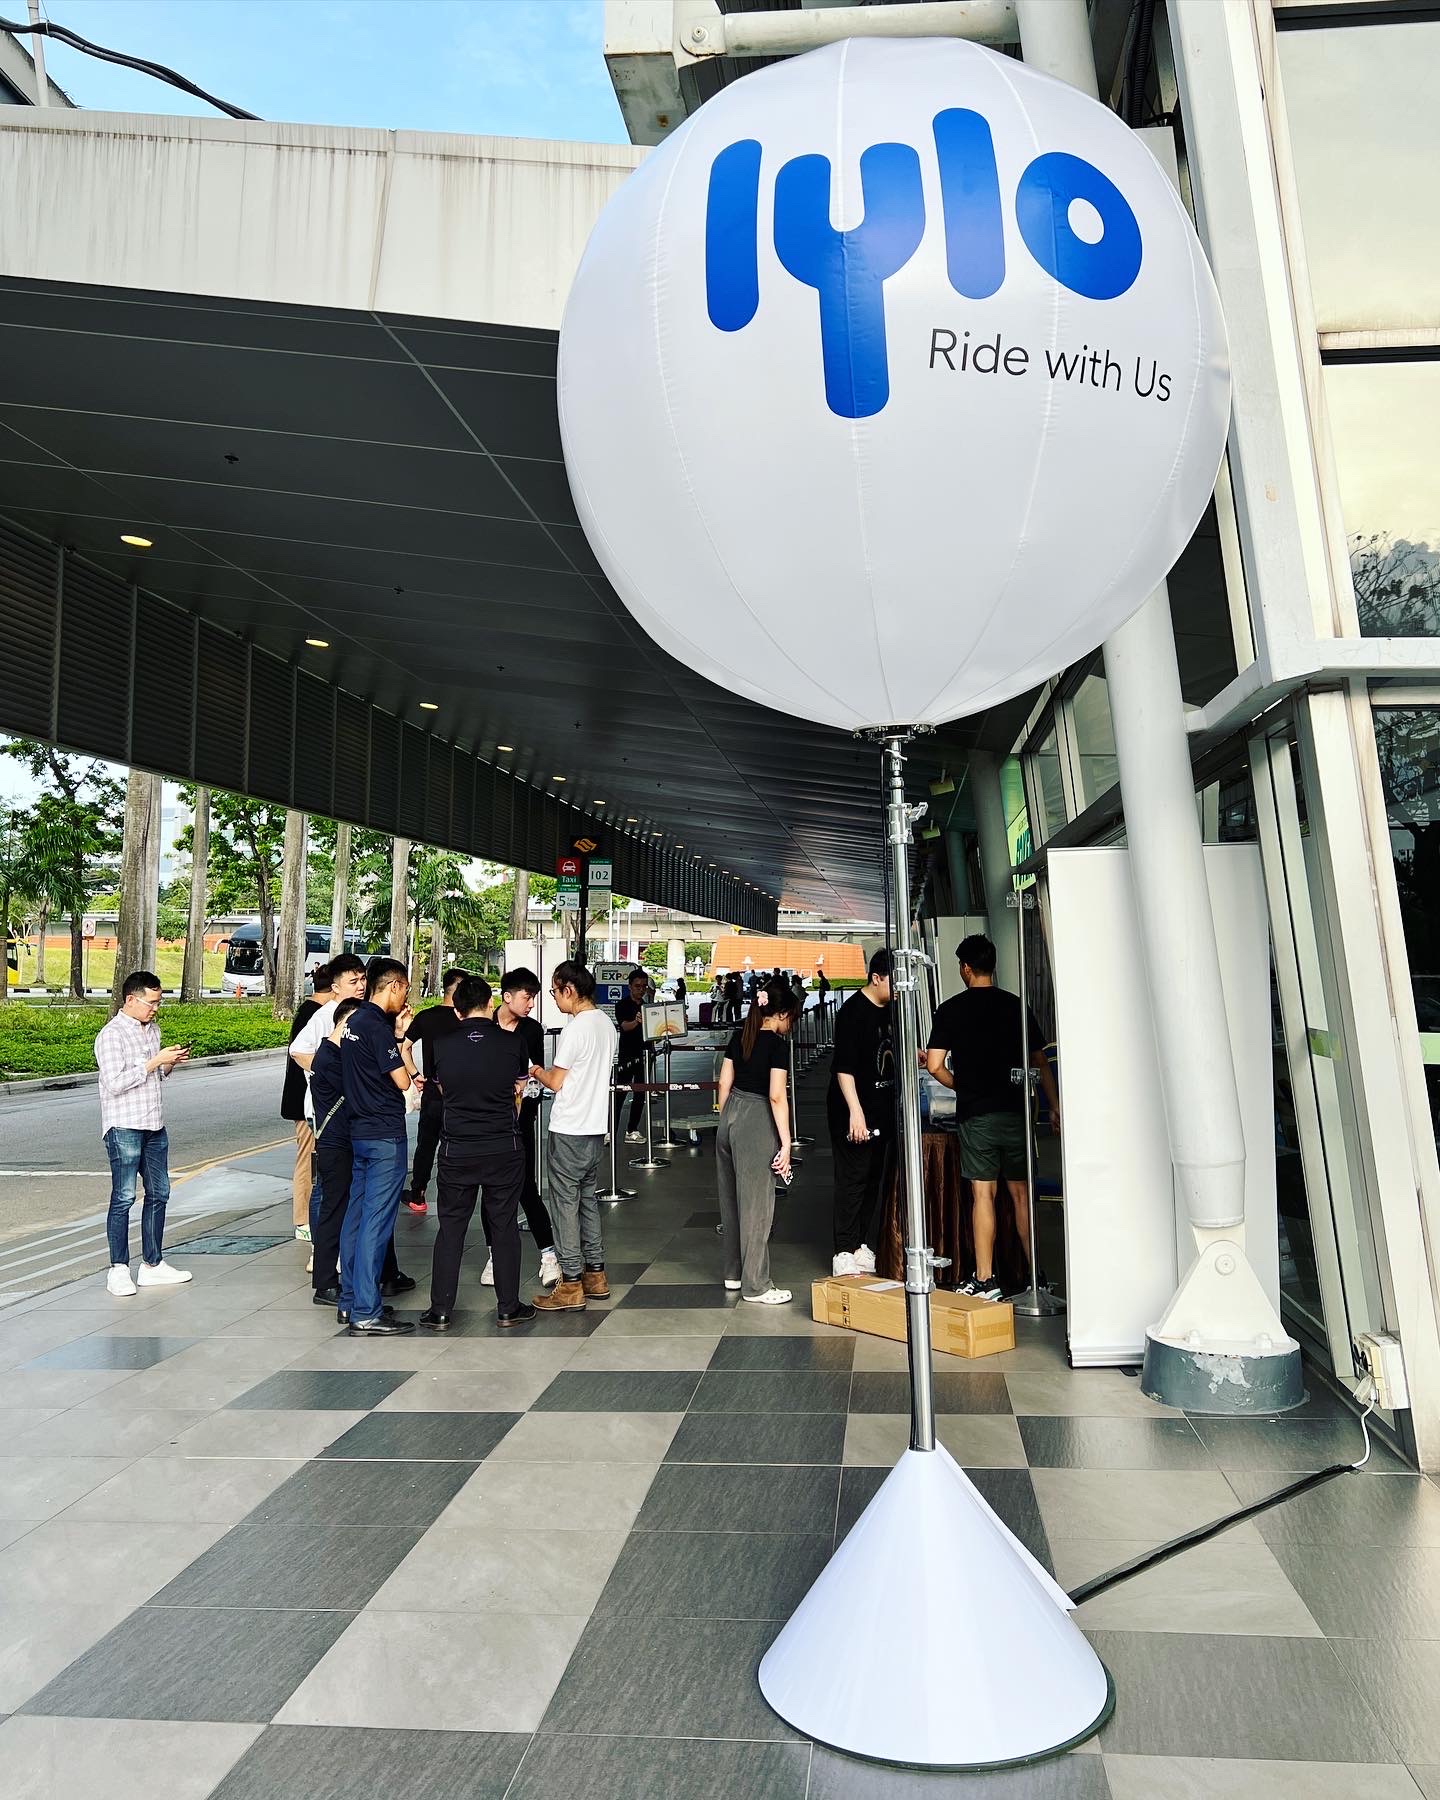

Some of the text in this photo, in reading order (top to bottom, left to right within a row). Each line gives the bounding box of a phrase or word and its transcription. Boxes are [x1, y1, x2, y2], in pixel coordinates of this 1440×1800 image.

[928, 328, 1172, 402] Ride with Us
[562, 875, 577, 883] Taxi
[591, 870, 609, 880] 102
[558, 895, 566, 907] 5
